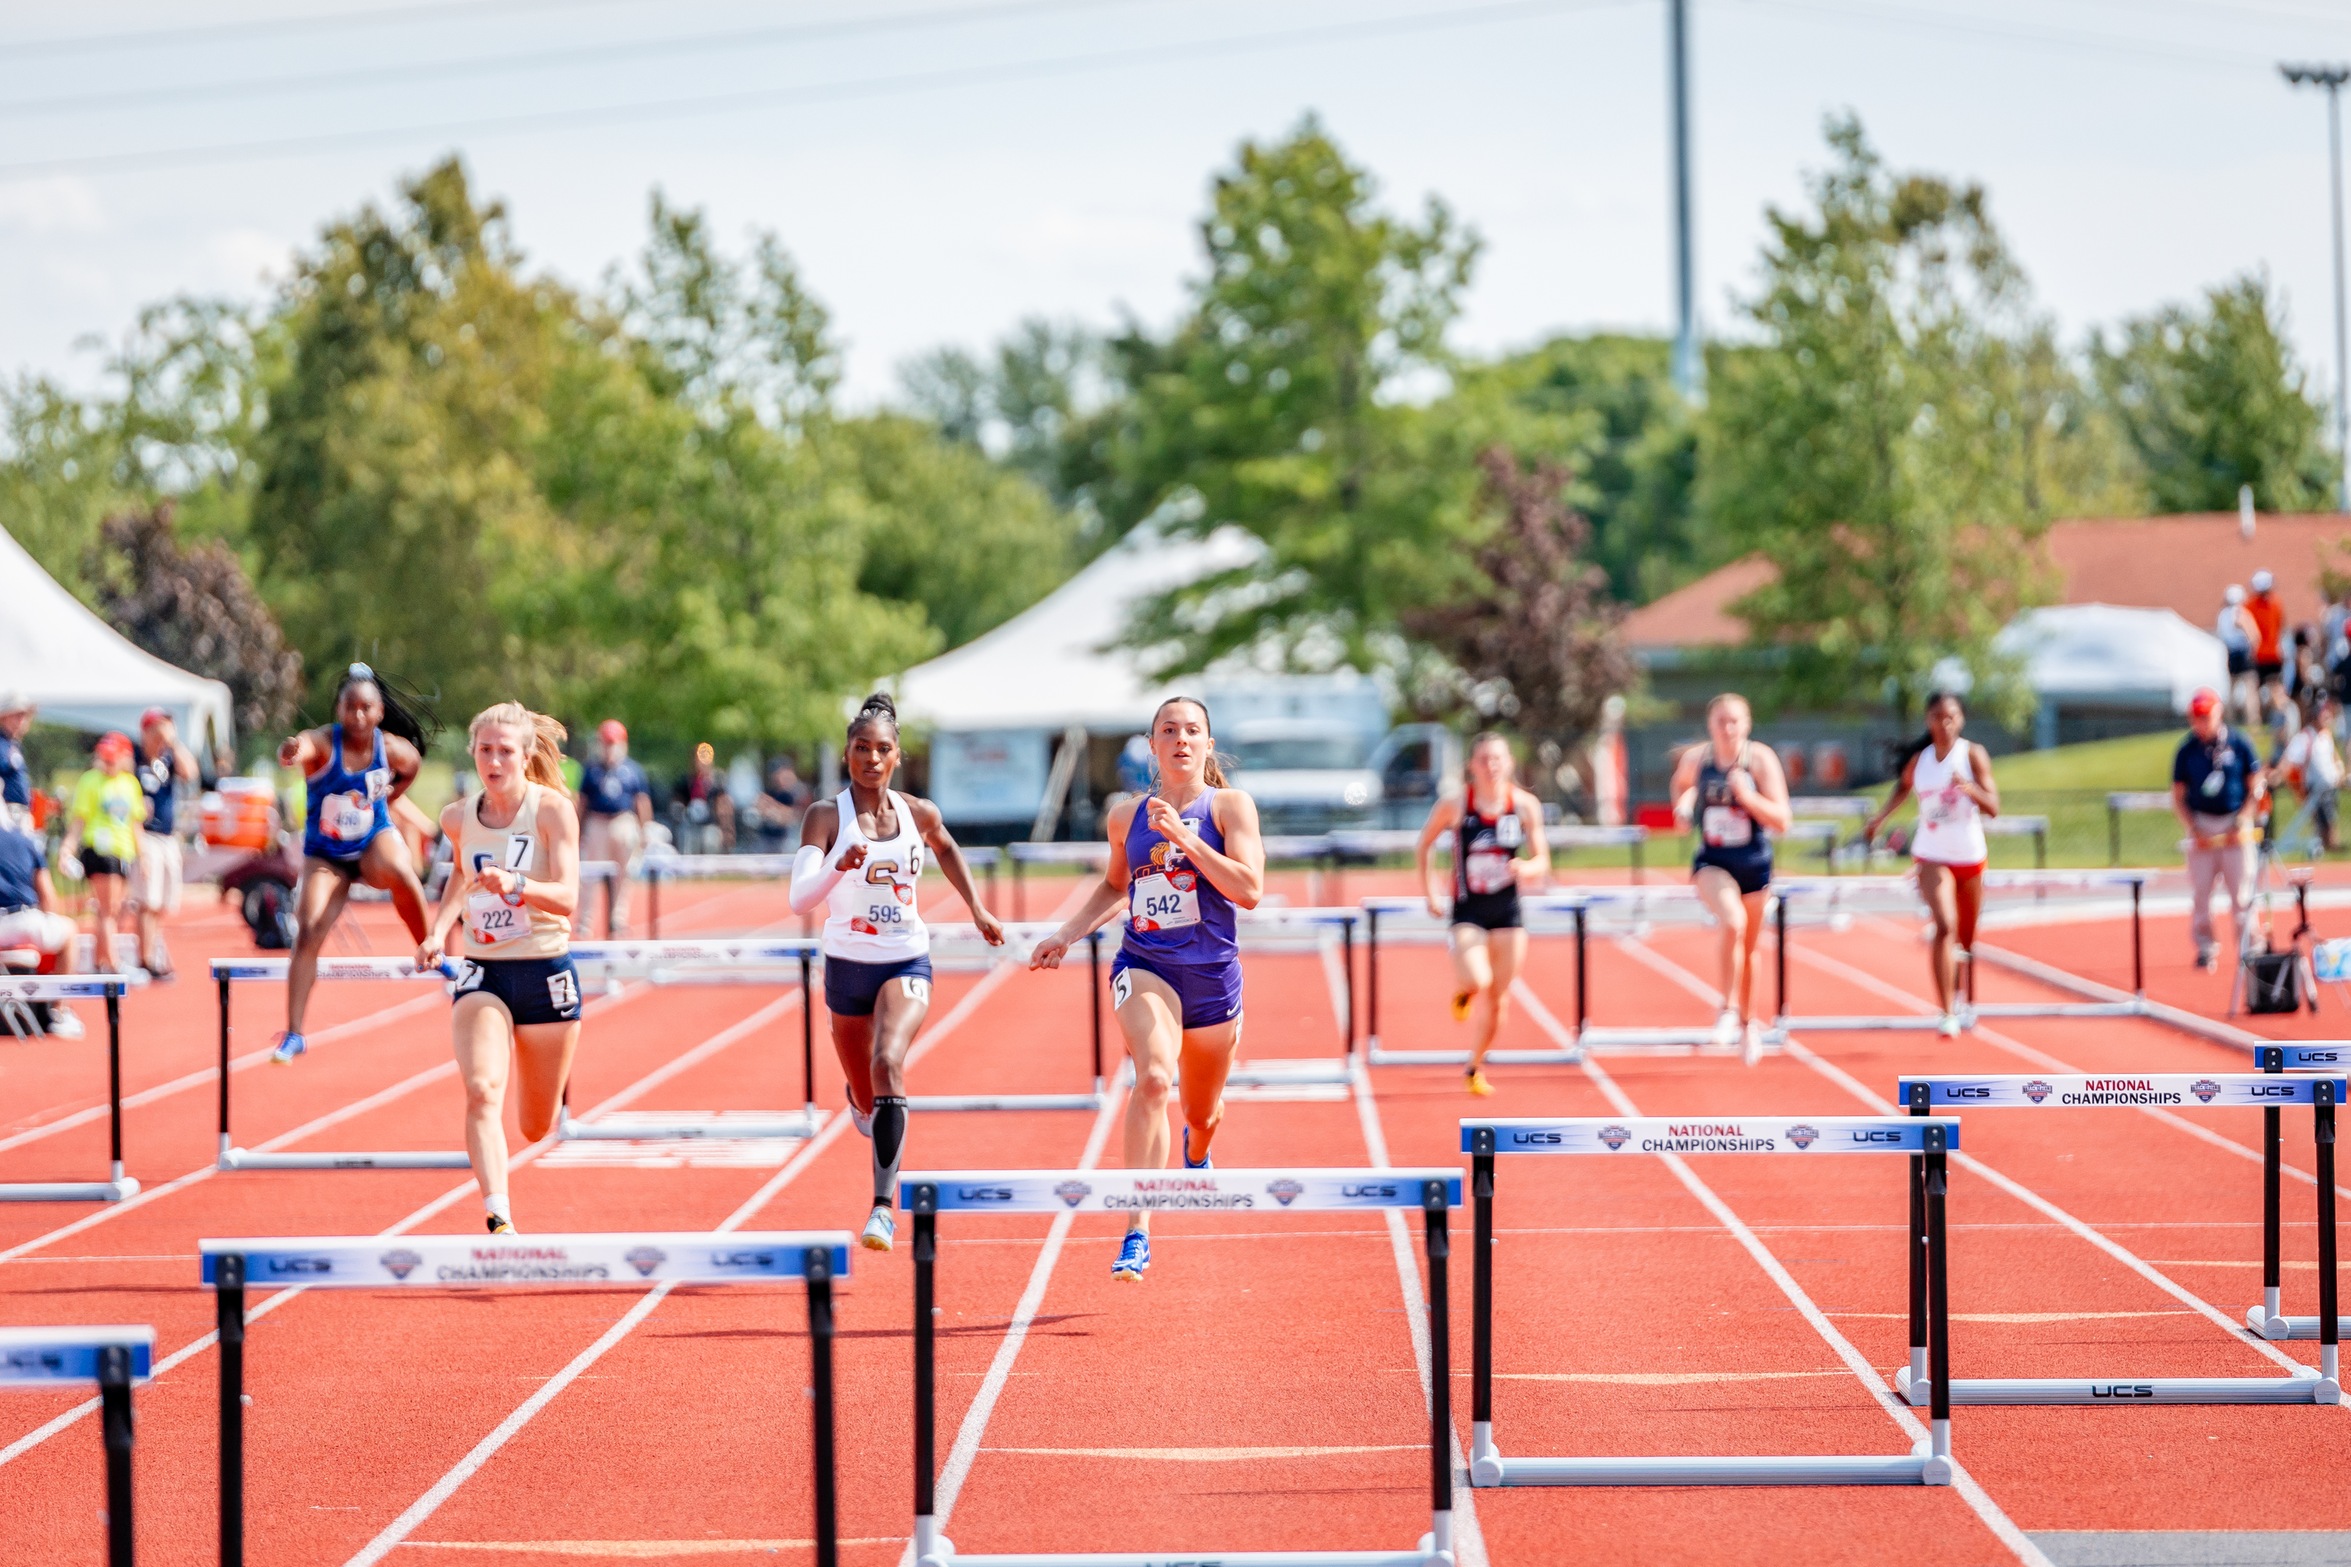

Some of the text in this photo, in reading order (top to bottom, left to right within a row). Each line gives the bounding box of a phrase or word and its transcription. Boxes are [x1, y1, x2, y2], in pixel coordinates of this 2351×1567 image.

[514, 838, 530, 868] 7
[910, 845, 920, 875] 6
[1146, 894, 1182, 917] 542
[482, 909, 515, 930] 222
[868, 905, 902, 924] 595
[465, 963, 478, 986] 7
[555, 978, 568, 1002] 7
[909, 977, 924, 998] 6
[1115, 974, 1127, 1005] 5
[2298, 1052, 2338, 1061] UCS
[2085, 1079, 2154, 1091] NATIONAL
[2251, 1086, 2295, 1096] UCS
[1946, 1087, 1990, 1098] UCS
[2061, 1092, 2182, 1105] CHAMPIONSHIPS
[1668, 1124, 1744, 1137] NATIONAL
[1852, 1131, 1902, 1142] UCS
[1513, 1132, 1562, 1144] UCS
[1642, 1138, 1775, 1151] CHAMPIONSHIPS
[1134, 1179, 1219, 1191] NATIONAL
[1342, 1184, 1397, 1198] UCS
[958, 1187, 1013, 1200] UCS
[1103, 1194, 1255, 1208] CHAMPIONSHIPS
[471, 1248, 567, 1260] NATIONAL
[436, 1264, 610, 1281] CHAMPIONSHIPS
[2091, 1384, 2154, 1398] UCS
